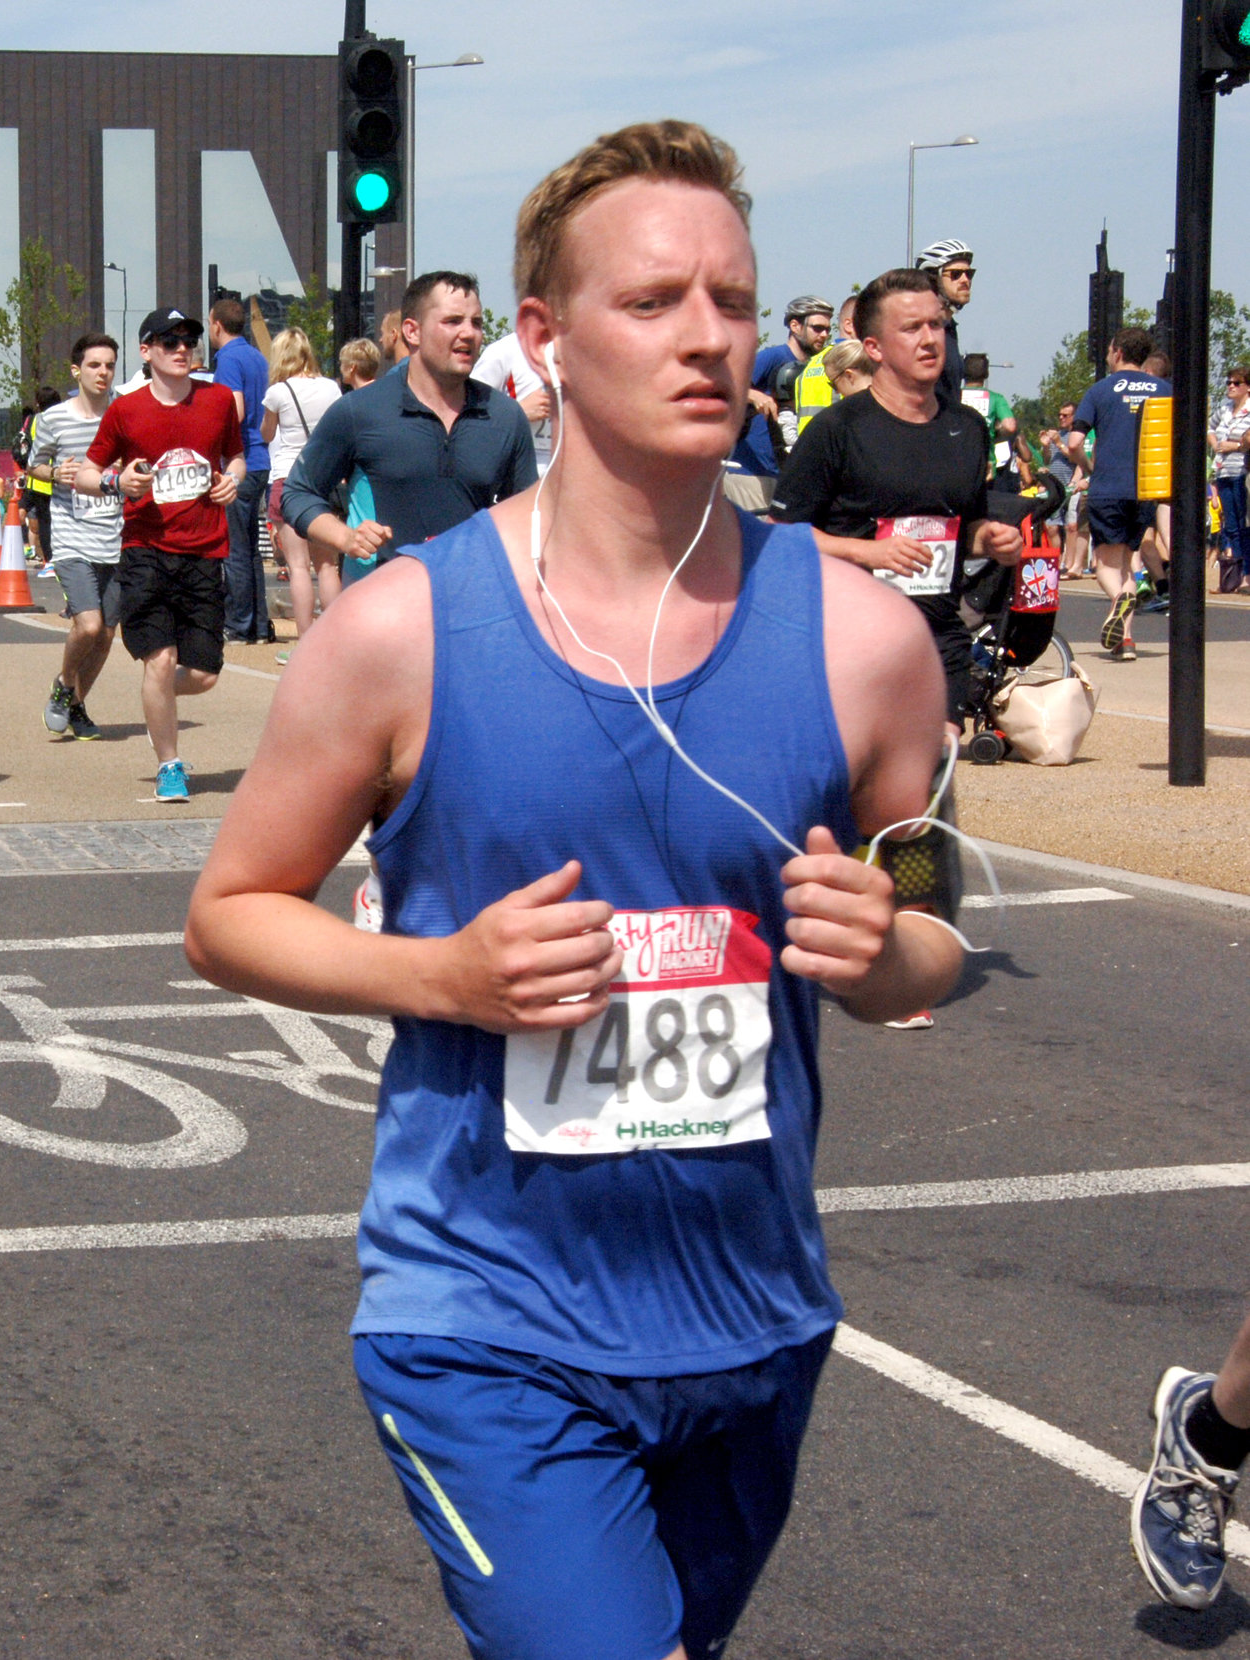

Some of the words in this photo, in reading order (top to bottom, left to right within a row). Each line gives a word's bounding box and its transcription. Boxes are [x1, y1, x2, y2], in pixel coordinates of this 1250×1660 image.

[1128, 382, 1157, 392] asics
[154, 464, 210, 493] 11493
[662, 911, 725, 952] RUN
[661, 949, 718, 970] HACKNEY
[544, 993, 741, 1105] 7488
[640, 1119, 732, 1139] Hackney
